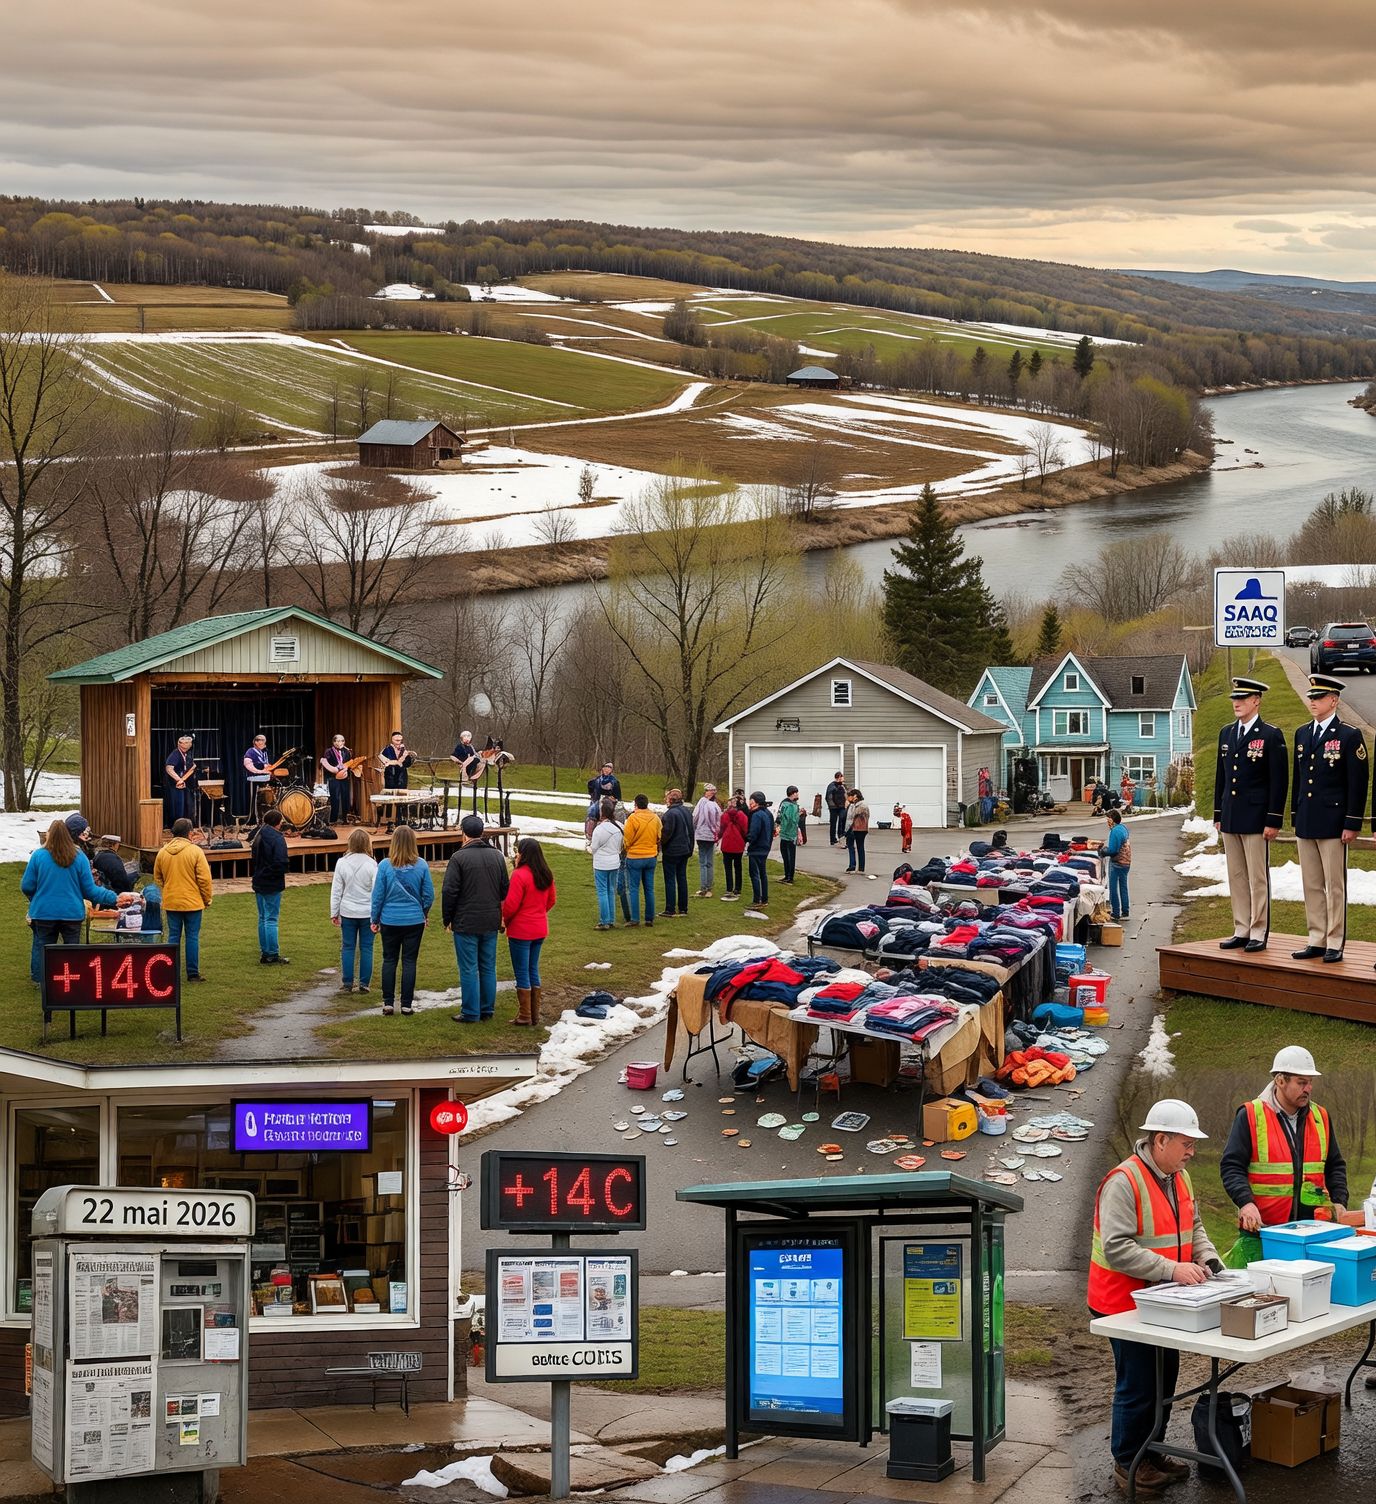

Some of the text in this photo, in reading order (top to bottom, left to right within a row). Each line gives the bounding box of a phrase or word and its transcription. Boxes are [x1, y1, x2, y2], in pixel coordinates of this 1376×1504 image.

[1224, 604, 1278, 622] SAAQ
[53, 953, 173, 999] +14C
[504, 1167, 633, 1216] +14C
[82, 1197, 236, 1227] 22 mai 2026
